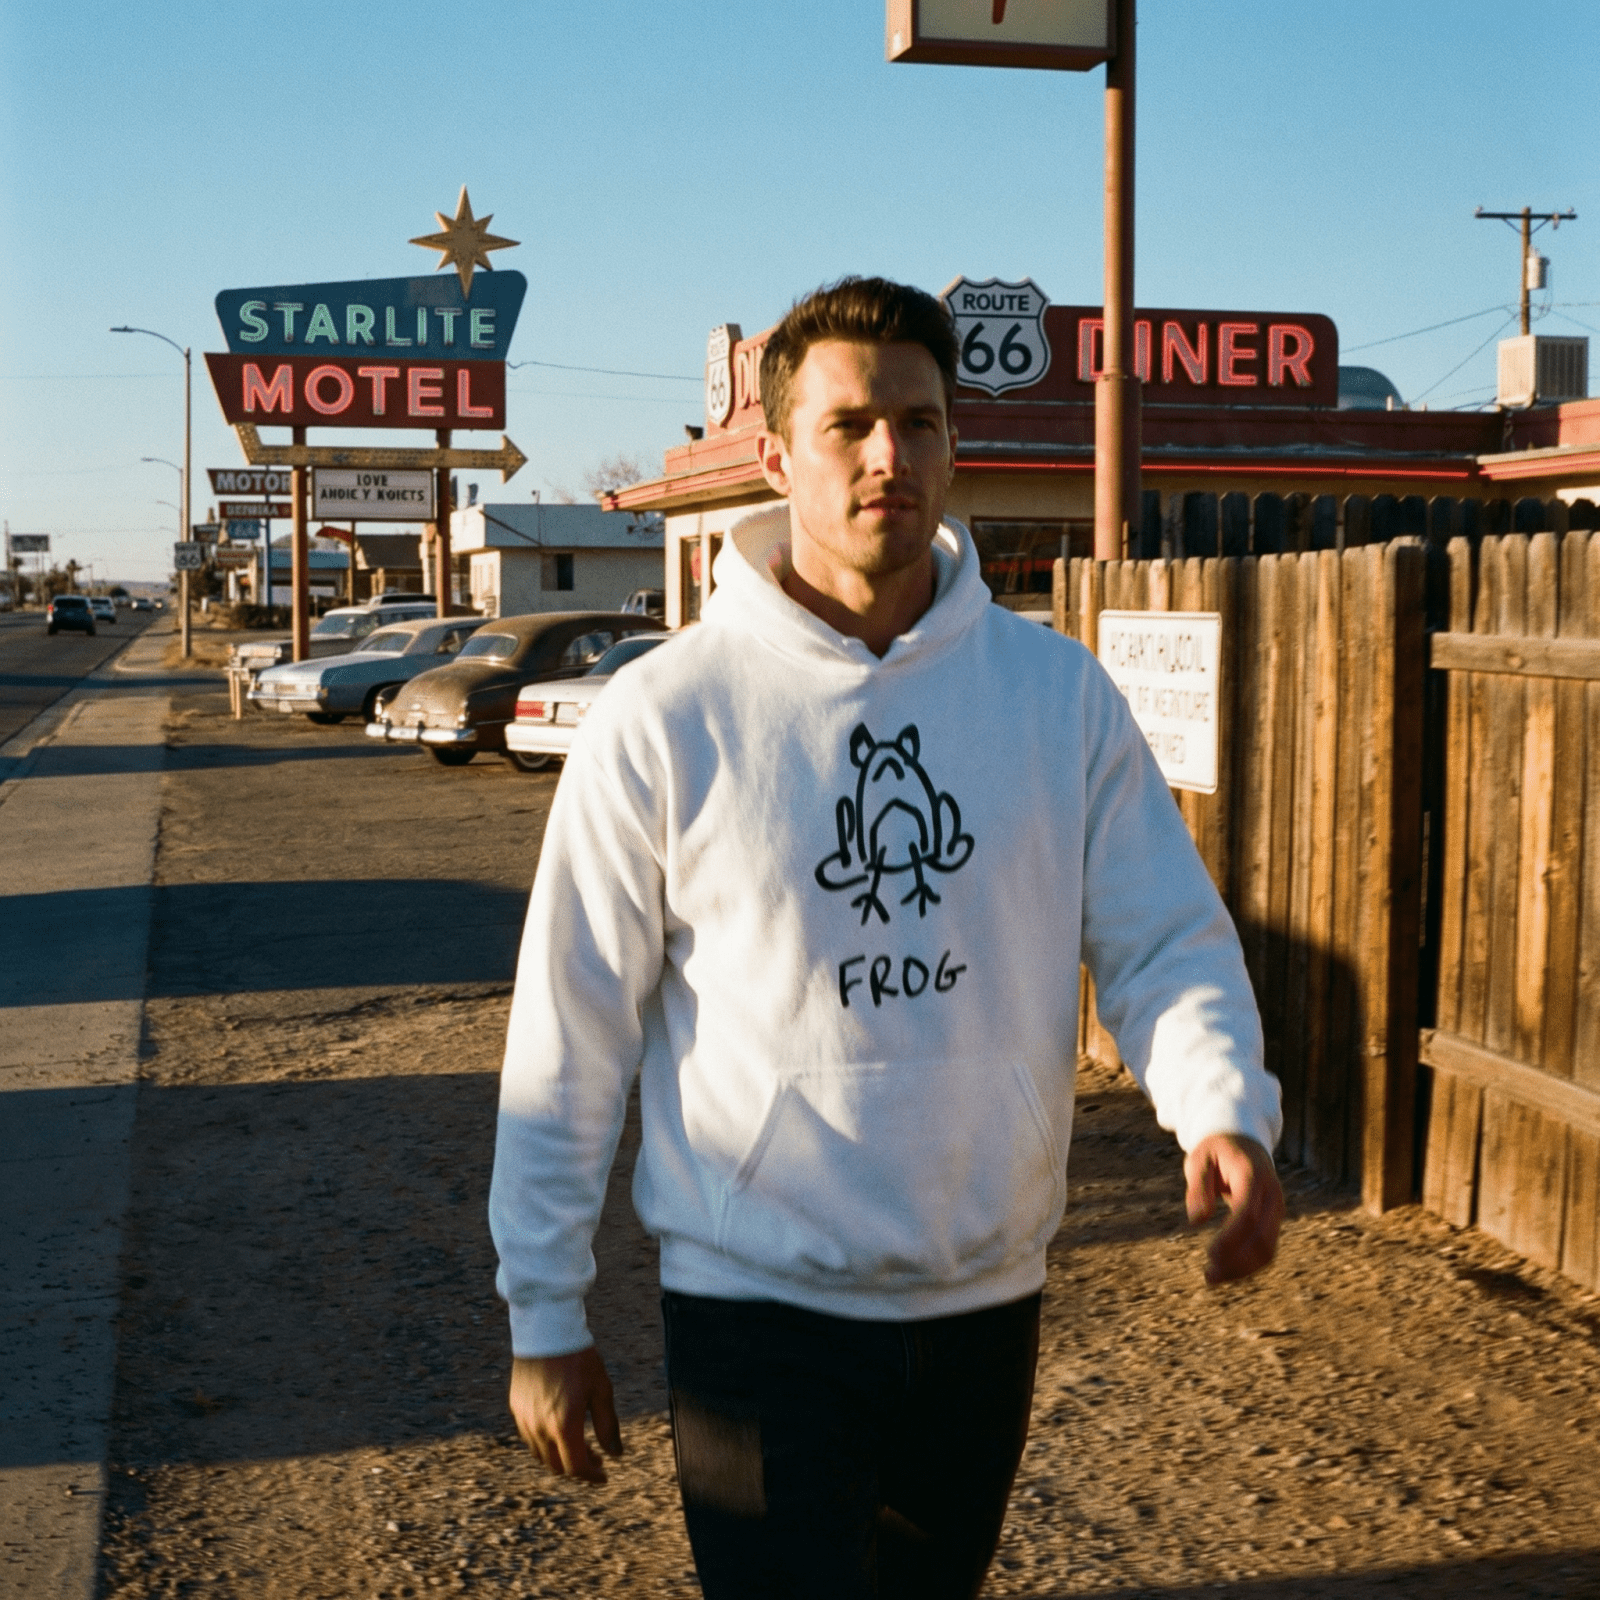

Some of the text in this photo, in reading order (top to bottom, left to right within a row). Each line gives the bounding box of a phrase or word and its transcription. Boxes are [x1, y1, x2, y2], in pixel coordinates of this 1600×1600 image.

[238, 299, 497, 349] STARLITE
[962, 292, 1031, 312] ROUTE
[960, 321, 1033, 375] 66
[242, 362, 495, 418] MOTEL
[838, 949, 967, 1008] FROG
